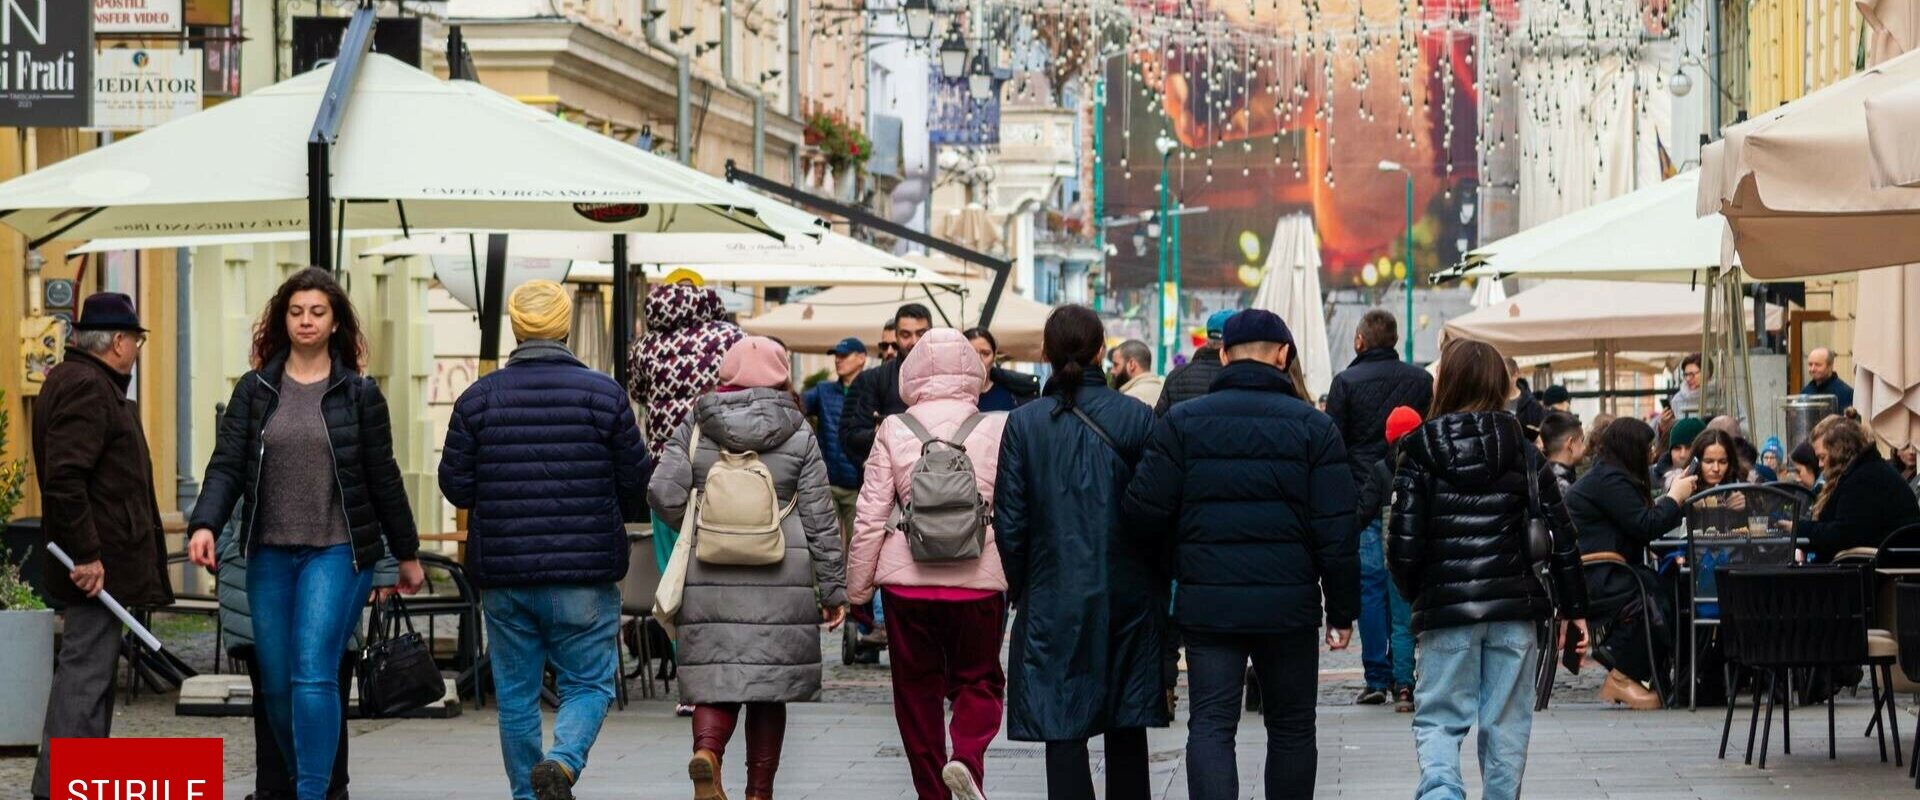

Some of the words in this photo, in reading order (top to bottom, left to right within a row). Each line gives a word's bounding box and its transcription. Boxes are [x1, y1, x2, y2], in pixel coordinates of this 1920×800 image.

[134, 13, 169, 25] VIDEO
[0, 51, 9, 91] i
[16, 51, 74, 91] Frati
